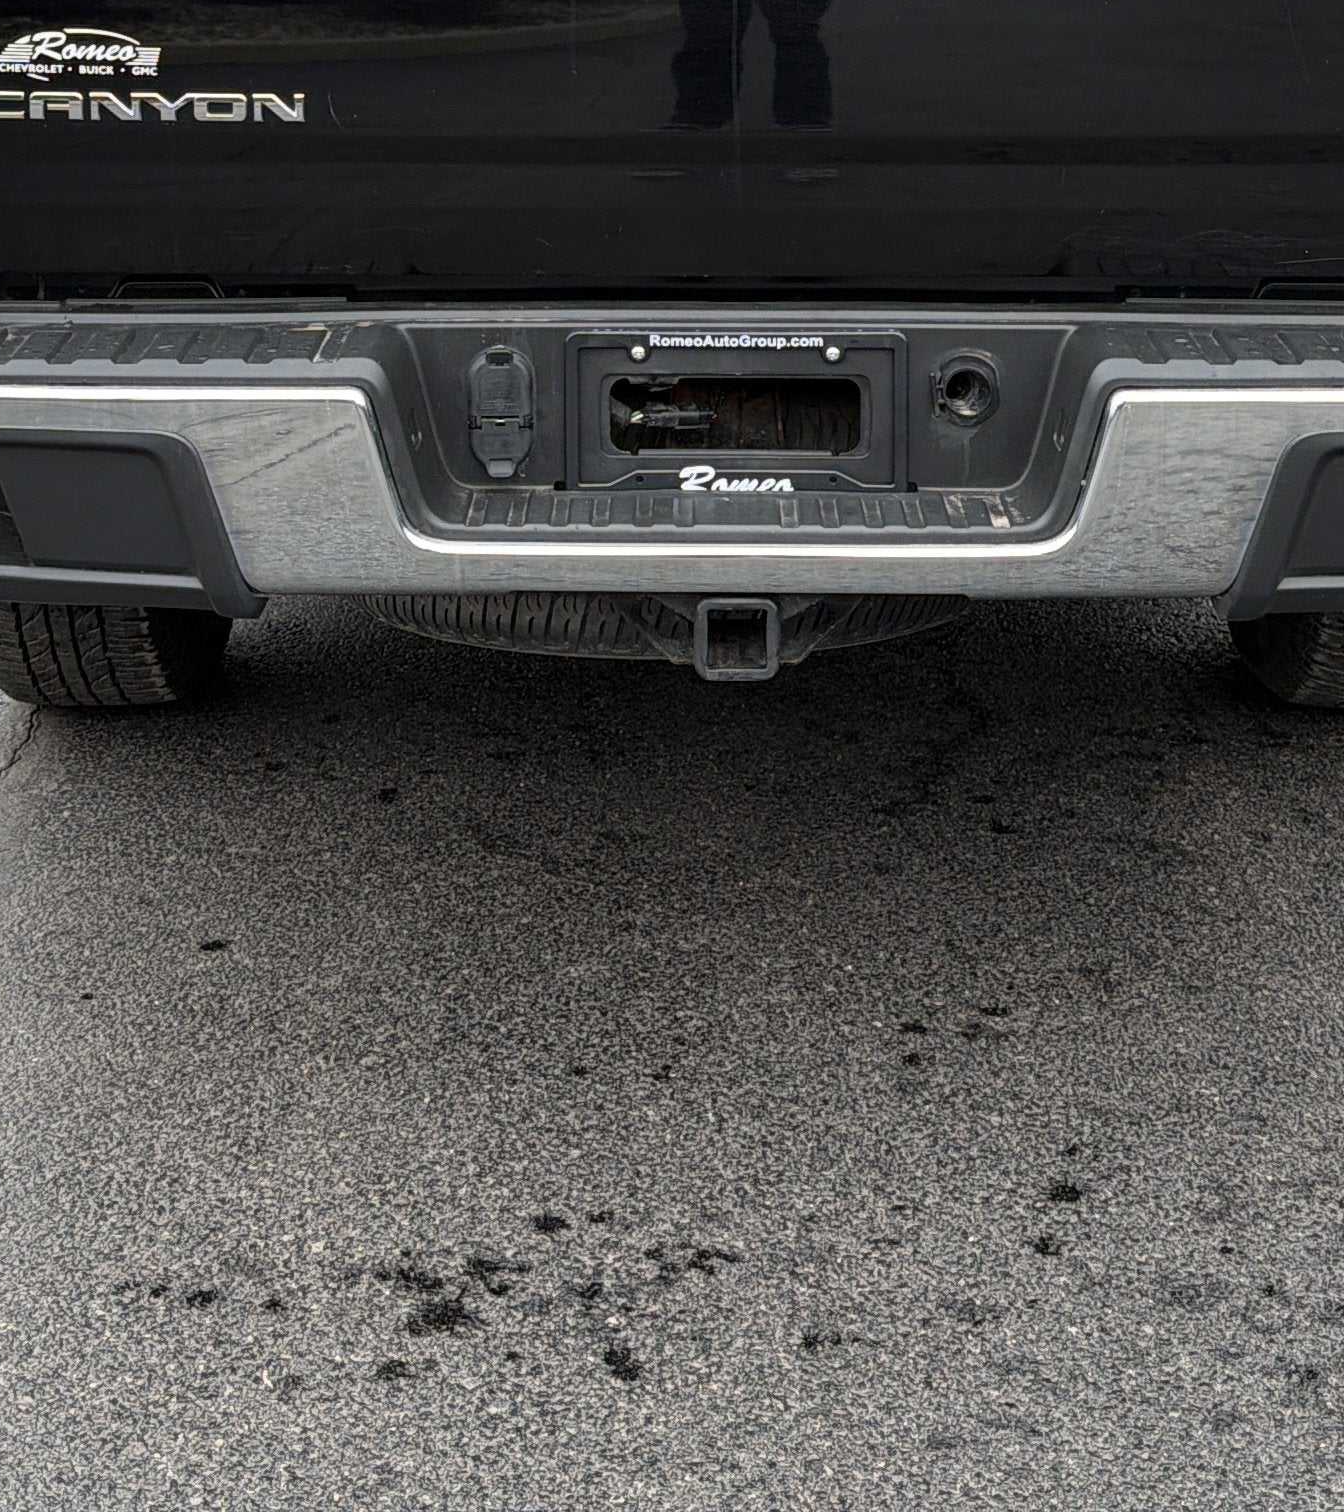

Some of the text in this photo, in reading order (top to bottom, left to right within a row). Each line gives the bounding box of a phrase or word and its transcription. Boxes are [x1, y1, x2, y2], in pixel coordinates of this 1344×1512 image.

[31, 31, 137, 61] Romeo
[79, 65, 114, 75] BUICK
[132, 66, 158, 76] GMC
[650, 335, 824, 349] RomeoAutoGroup.com
